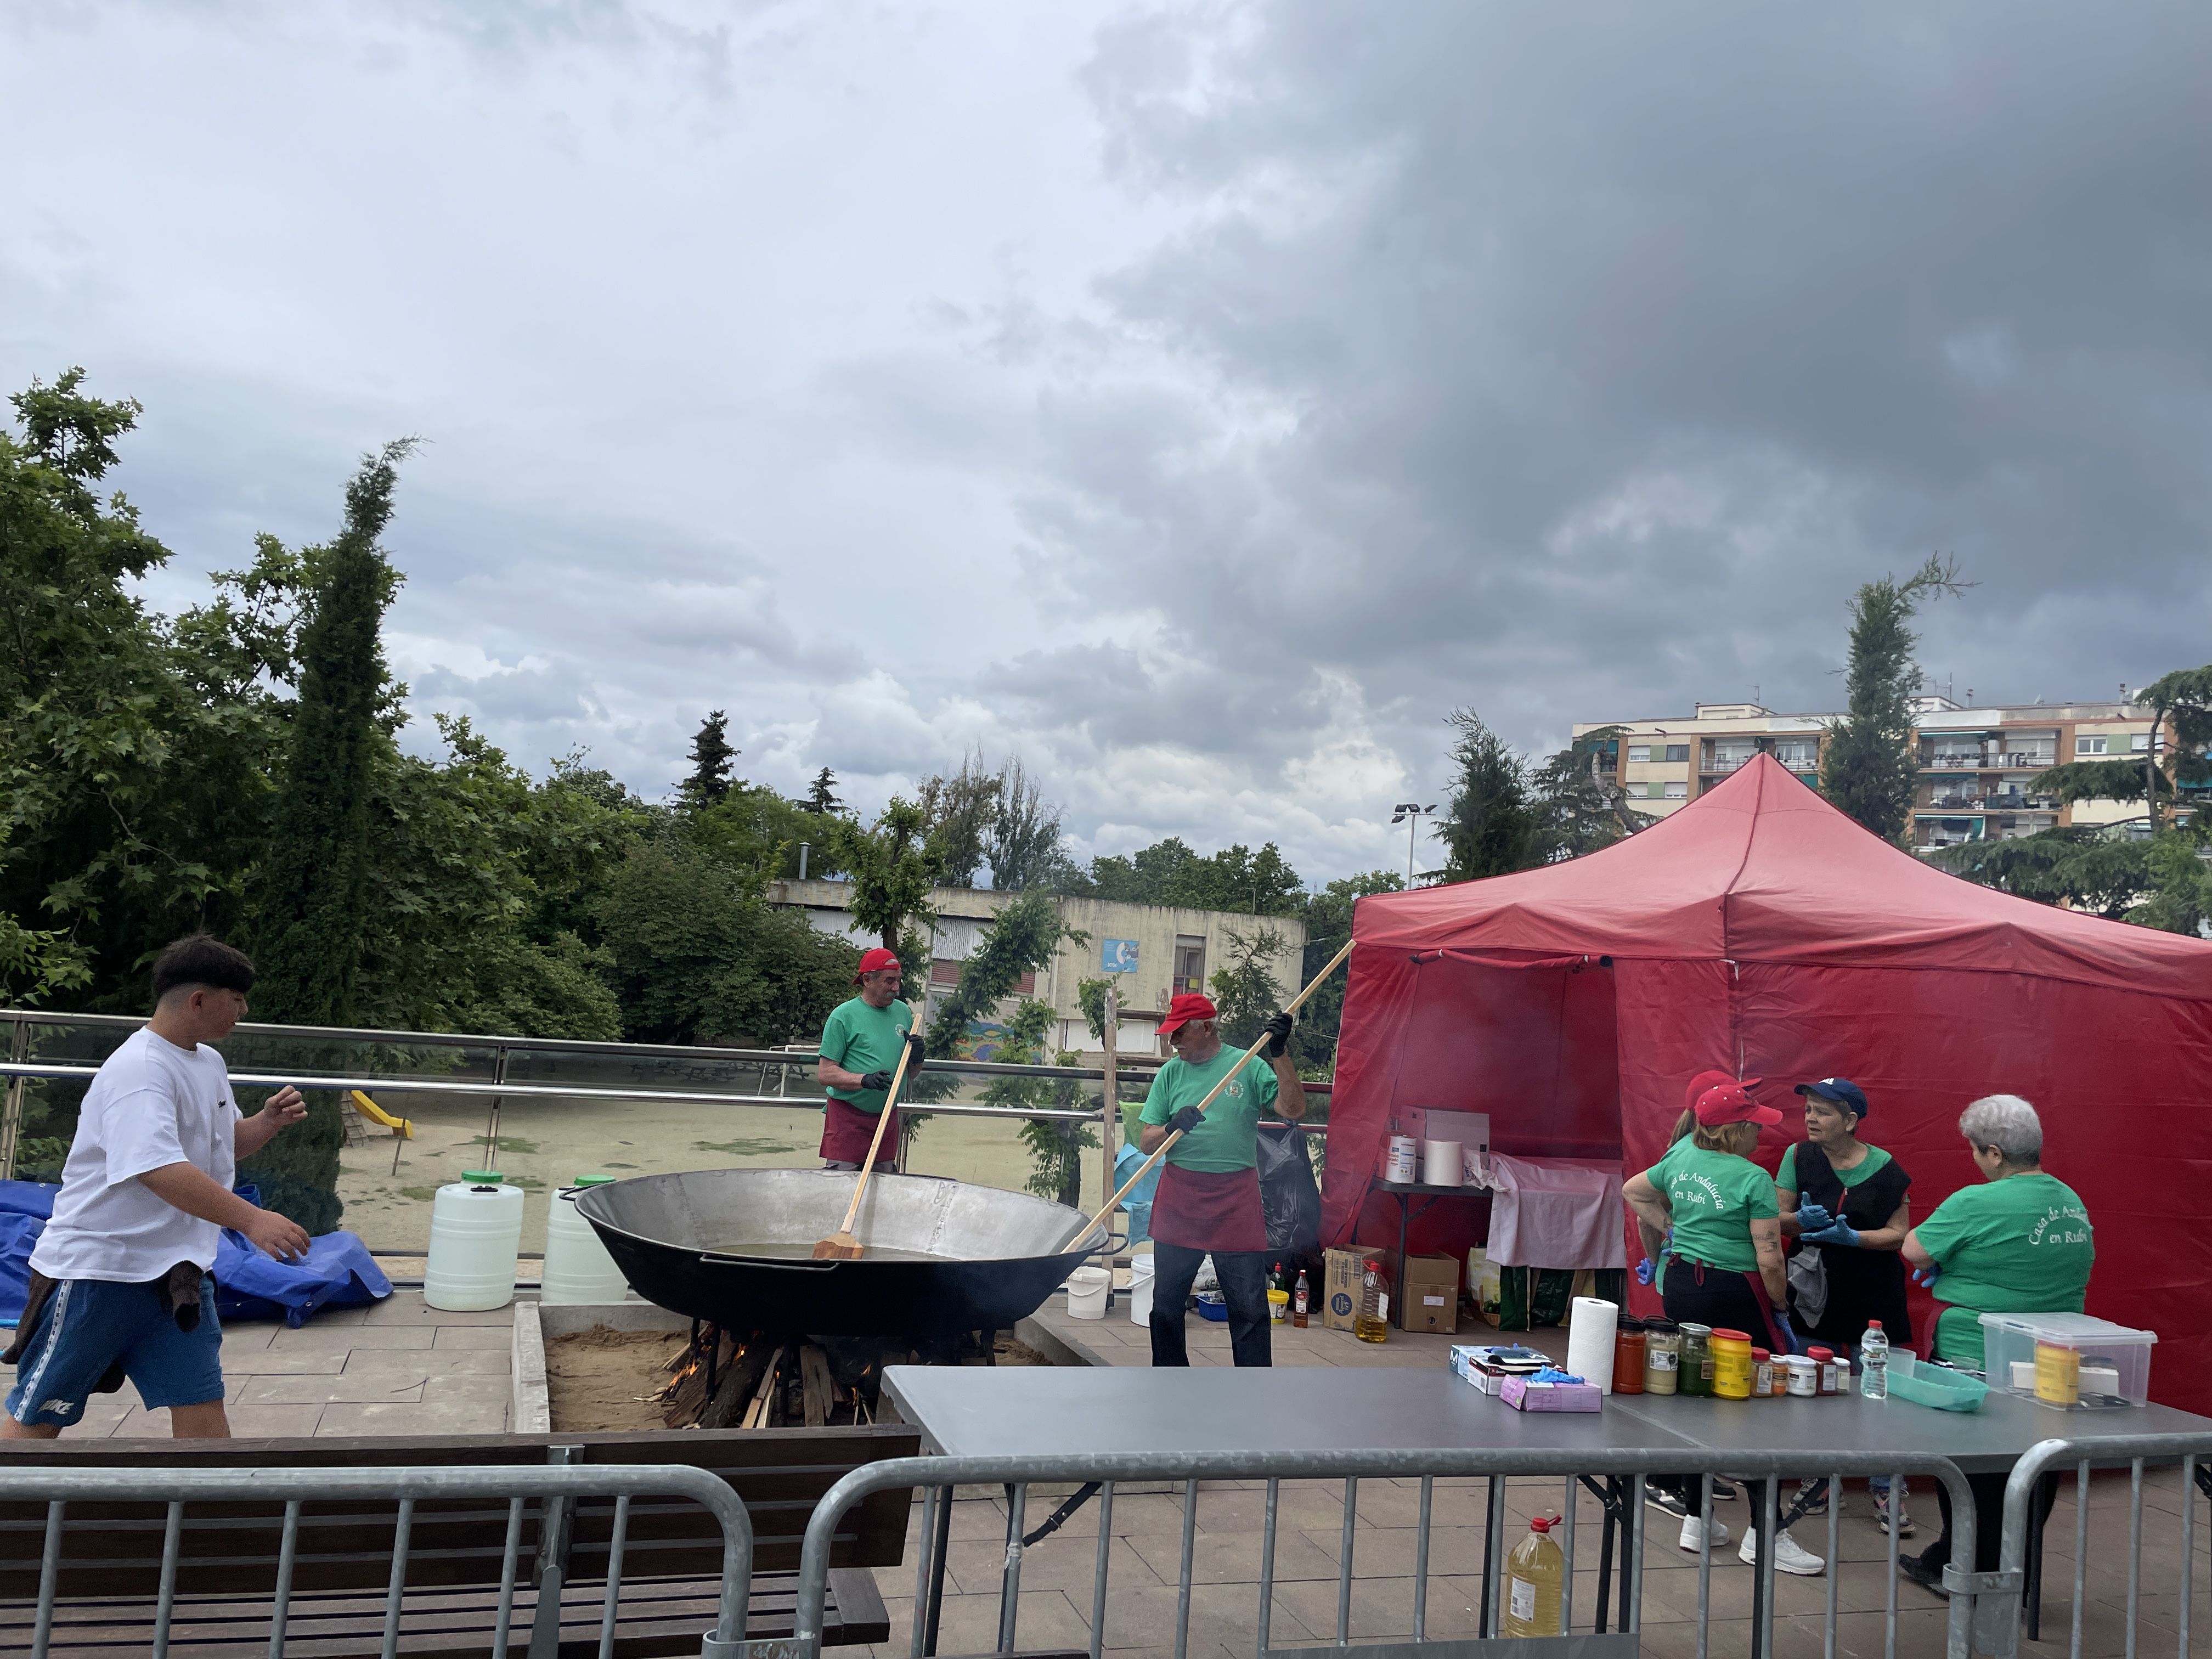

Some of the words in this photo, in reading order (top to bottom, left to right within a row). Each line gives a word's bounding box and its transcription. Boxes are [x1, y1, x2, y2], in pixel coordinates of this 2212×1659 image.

[1675, 1190, 1684, 1199] en
[1687, 1191, 1707, 1204] Rubí
[1679, 1170, 1688, 1181] de
[1690, 1172, 1726, 1210] Andalucía
[2029, 1217, 2049, 1245] Casa
[2049, 1206, 2060, 1221] de
[2050, 1234, 2062, 1244] en
[1450, 1350, 1458, 1364] M
